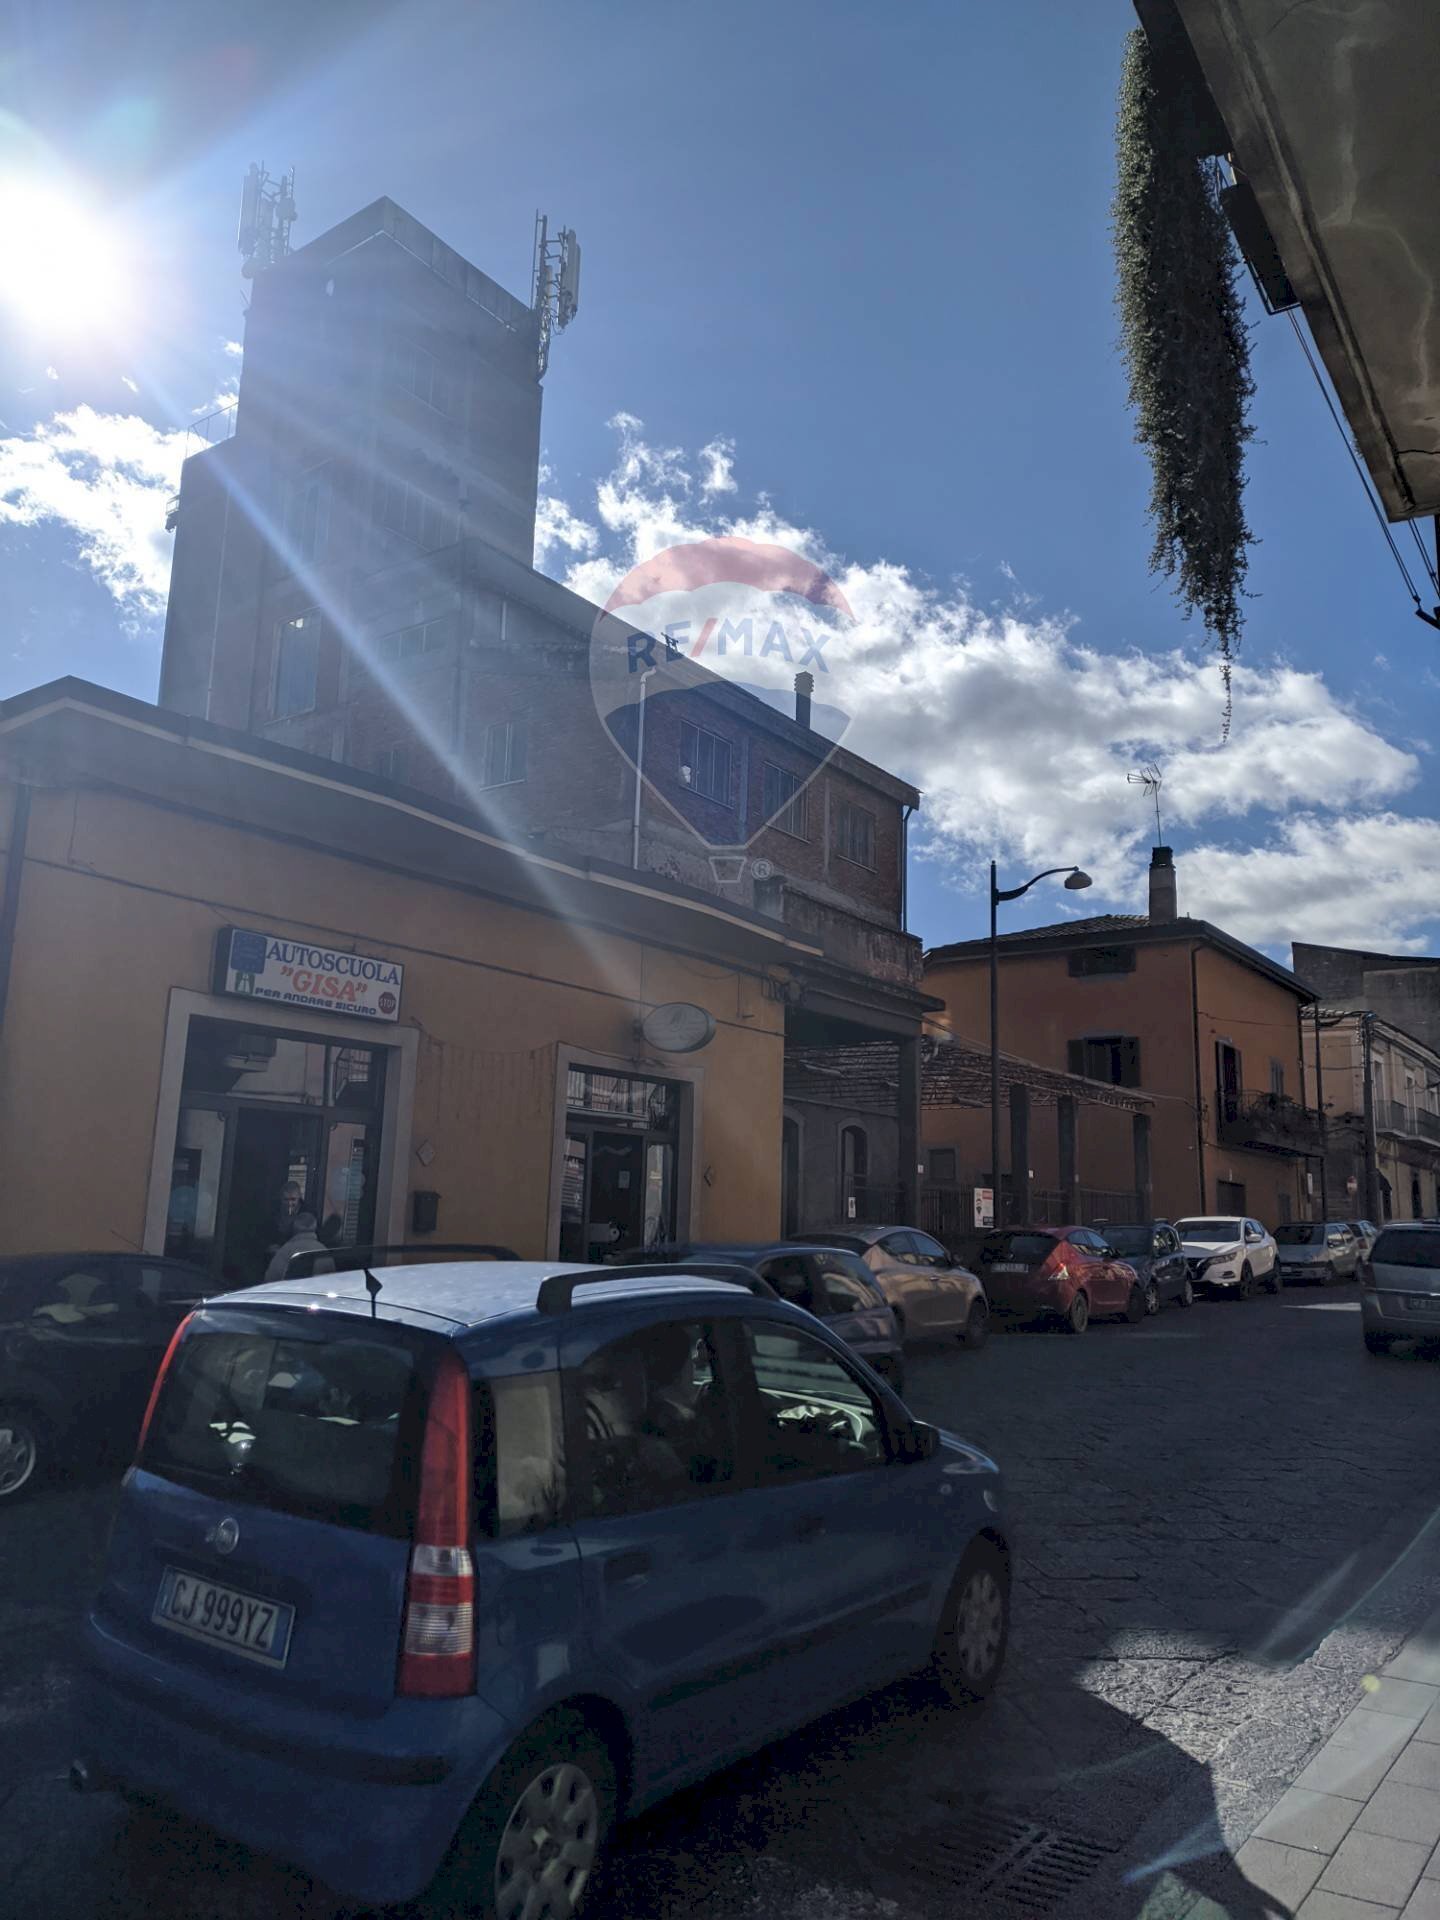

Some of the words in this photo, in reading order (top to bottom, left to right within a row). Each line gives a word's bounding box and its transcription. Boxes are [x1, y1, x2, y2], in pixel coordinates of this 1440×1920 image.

[266, 939, 401, 985] AUTOSCUOLA
[255, 987, 282, 999] PER
[283, 992, 333, 1008] ANDARE
[335, 1000, 378, 1015] SICURO
